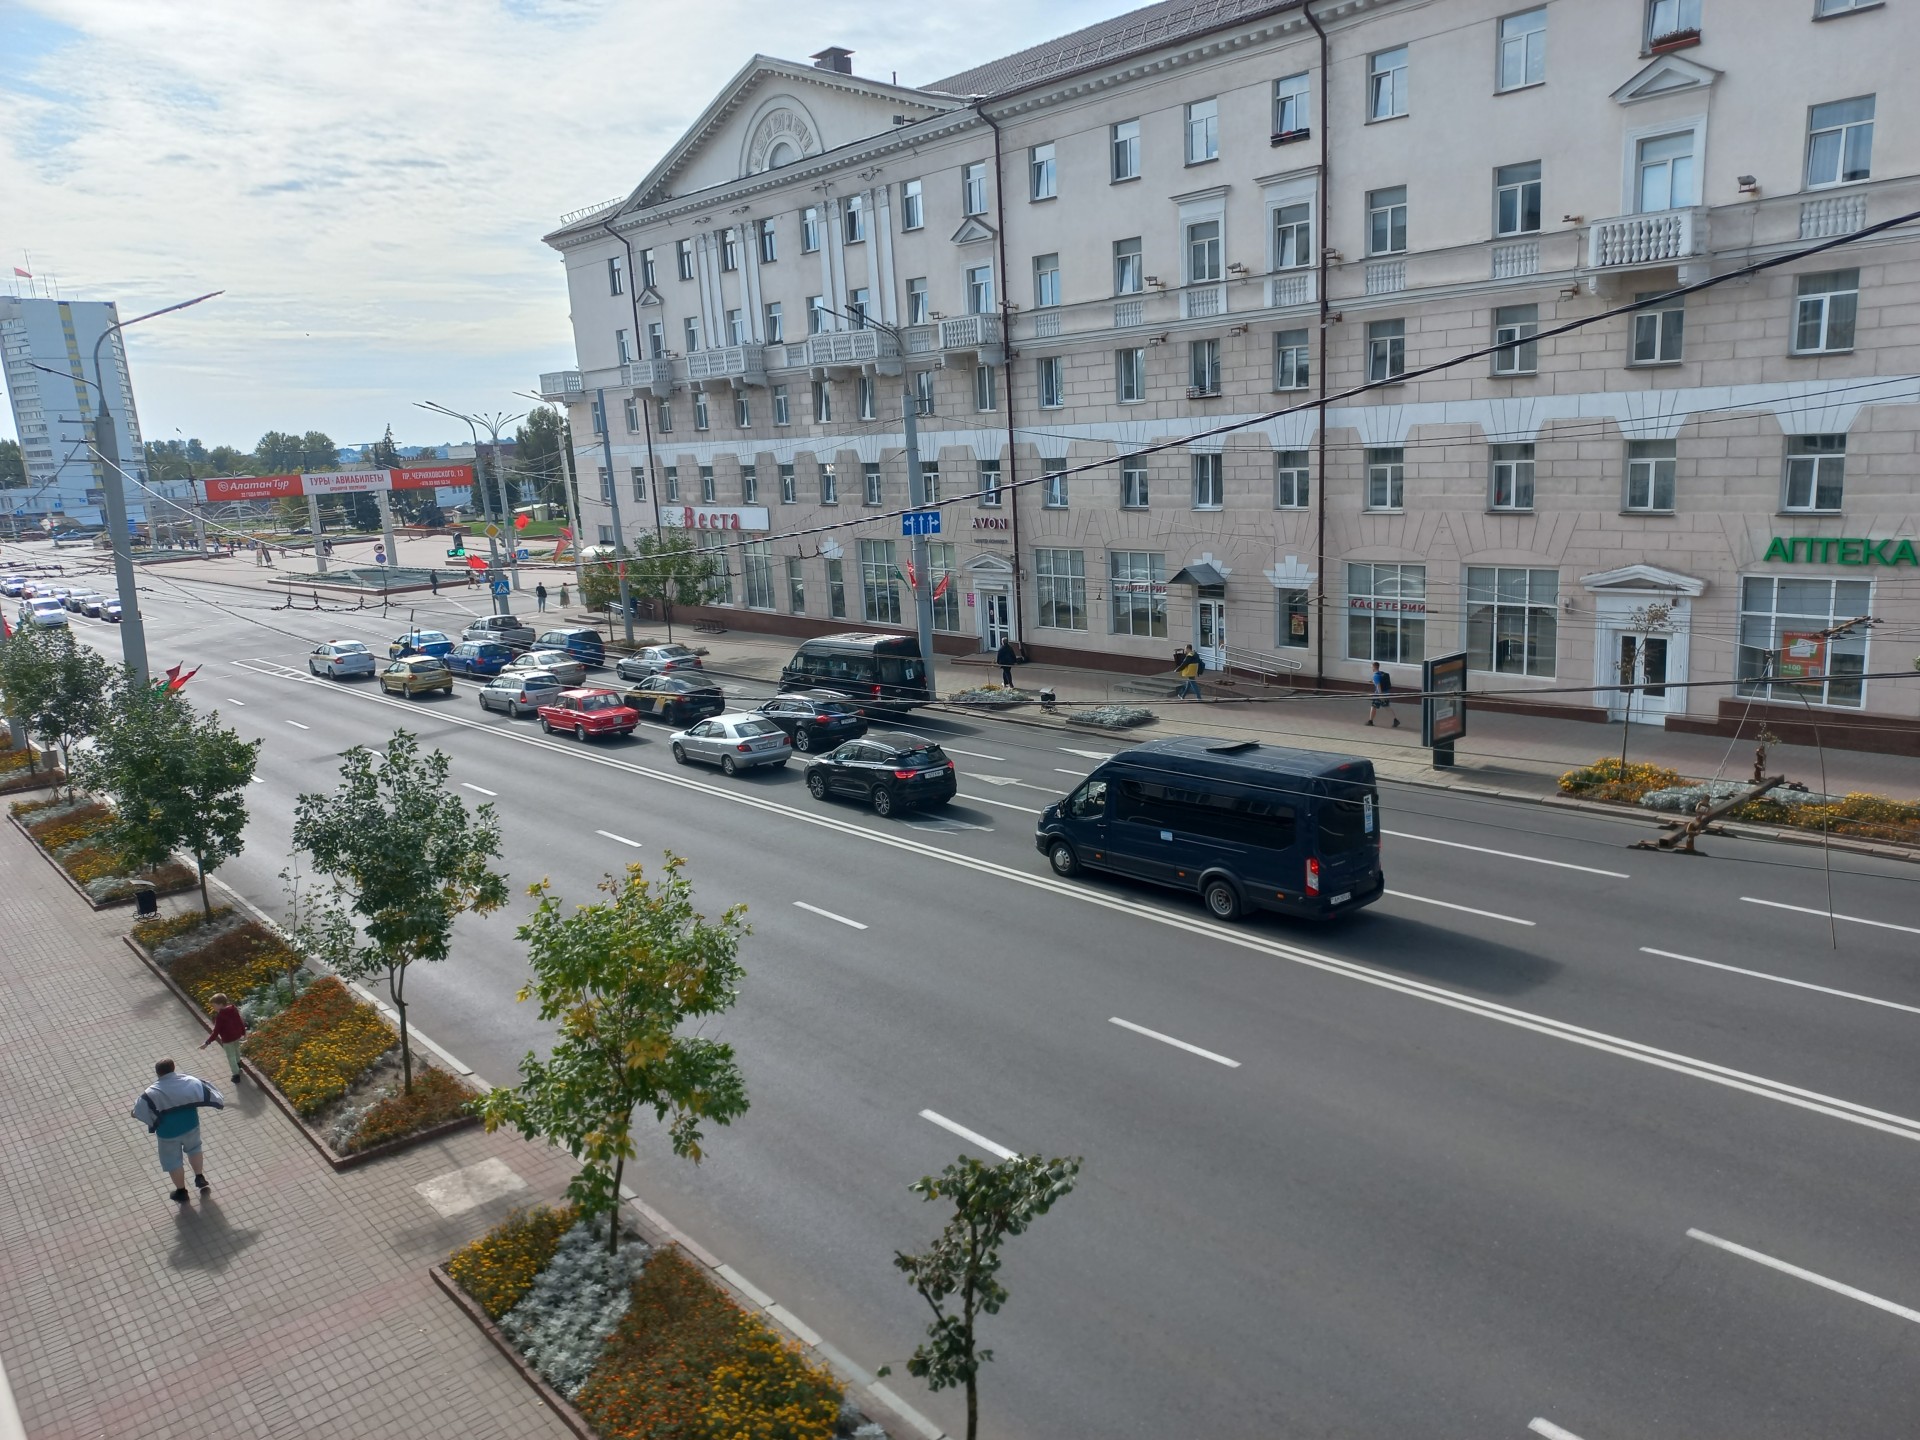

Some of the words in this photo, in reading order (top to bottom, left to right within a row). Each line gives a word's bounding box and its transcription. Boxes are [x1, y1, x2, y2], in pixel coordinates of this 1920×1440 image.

[457, 469, 464, 477] 13
[230, 481, 272, 490] Алатан
[273, 479, 289, 490] Тур
[309, 477, 330, 486] ТУРЫ
[335, 474, 384, 484] АВИАБИЛЕТЫ
[684, 506, 741, 529] Веста
[972, 517, 1008, 530] AVON
[1763, 536, 1919, 566] АПТЕКА
